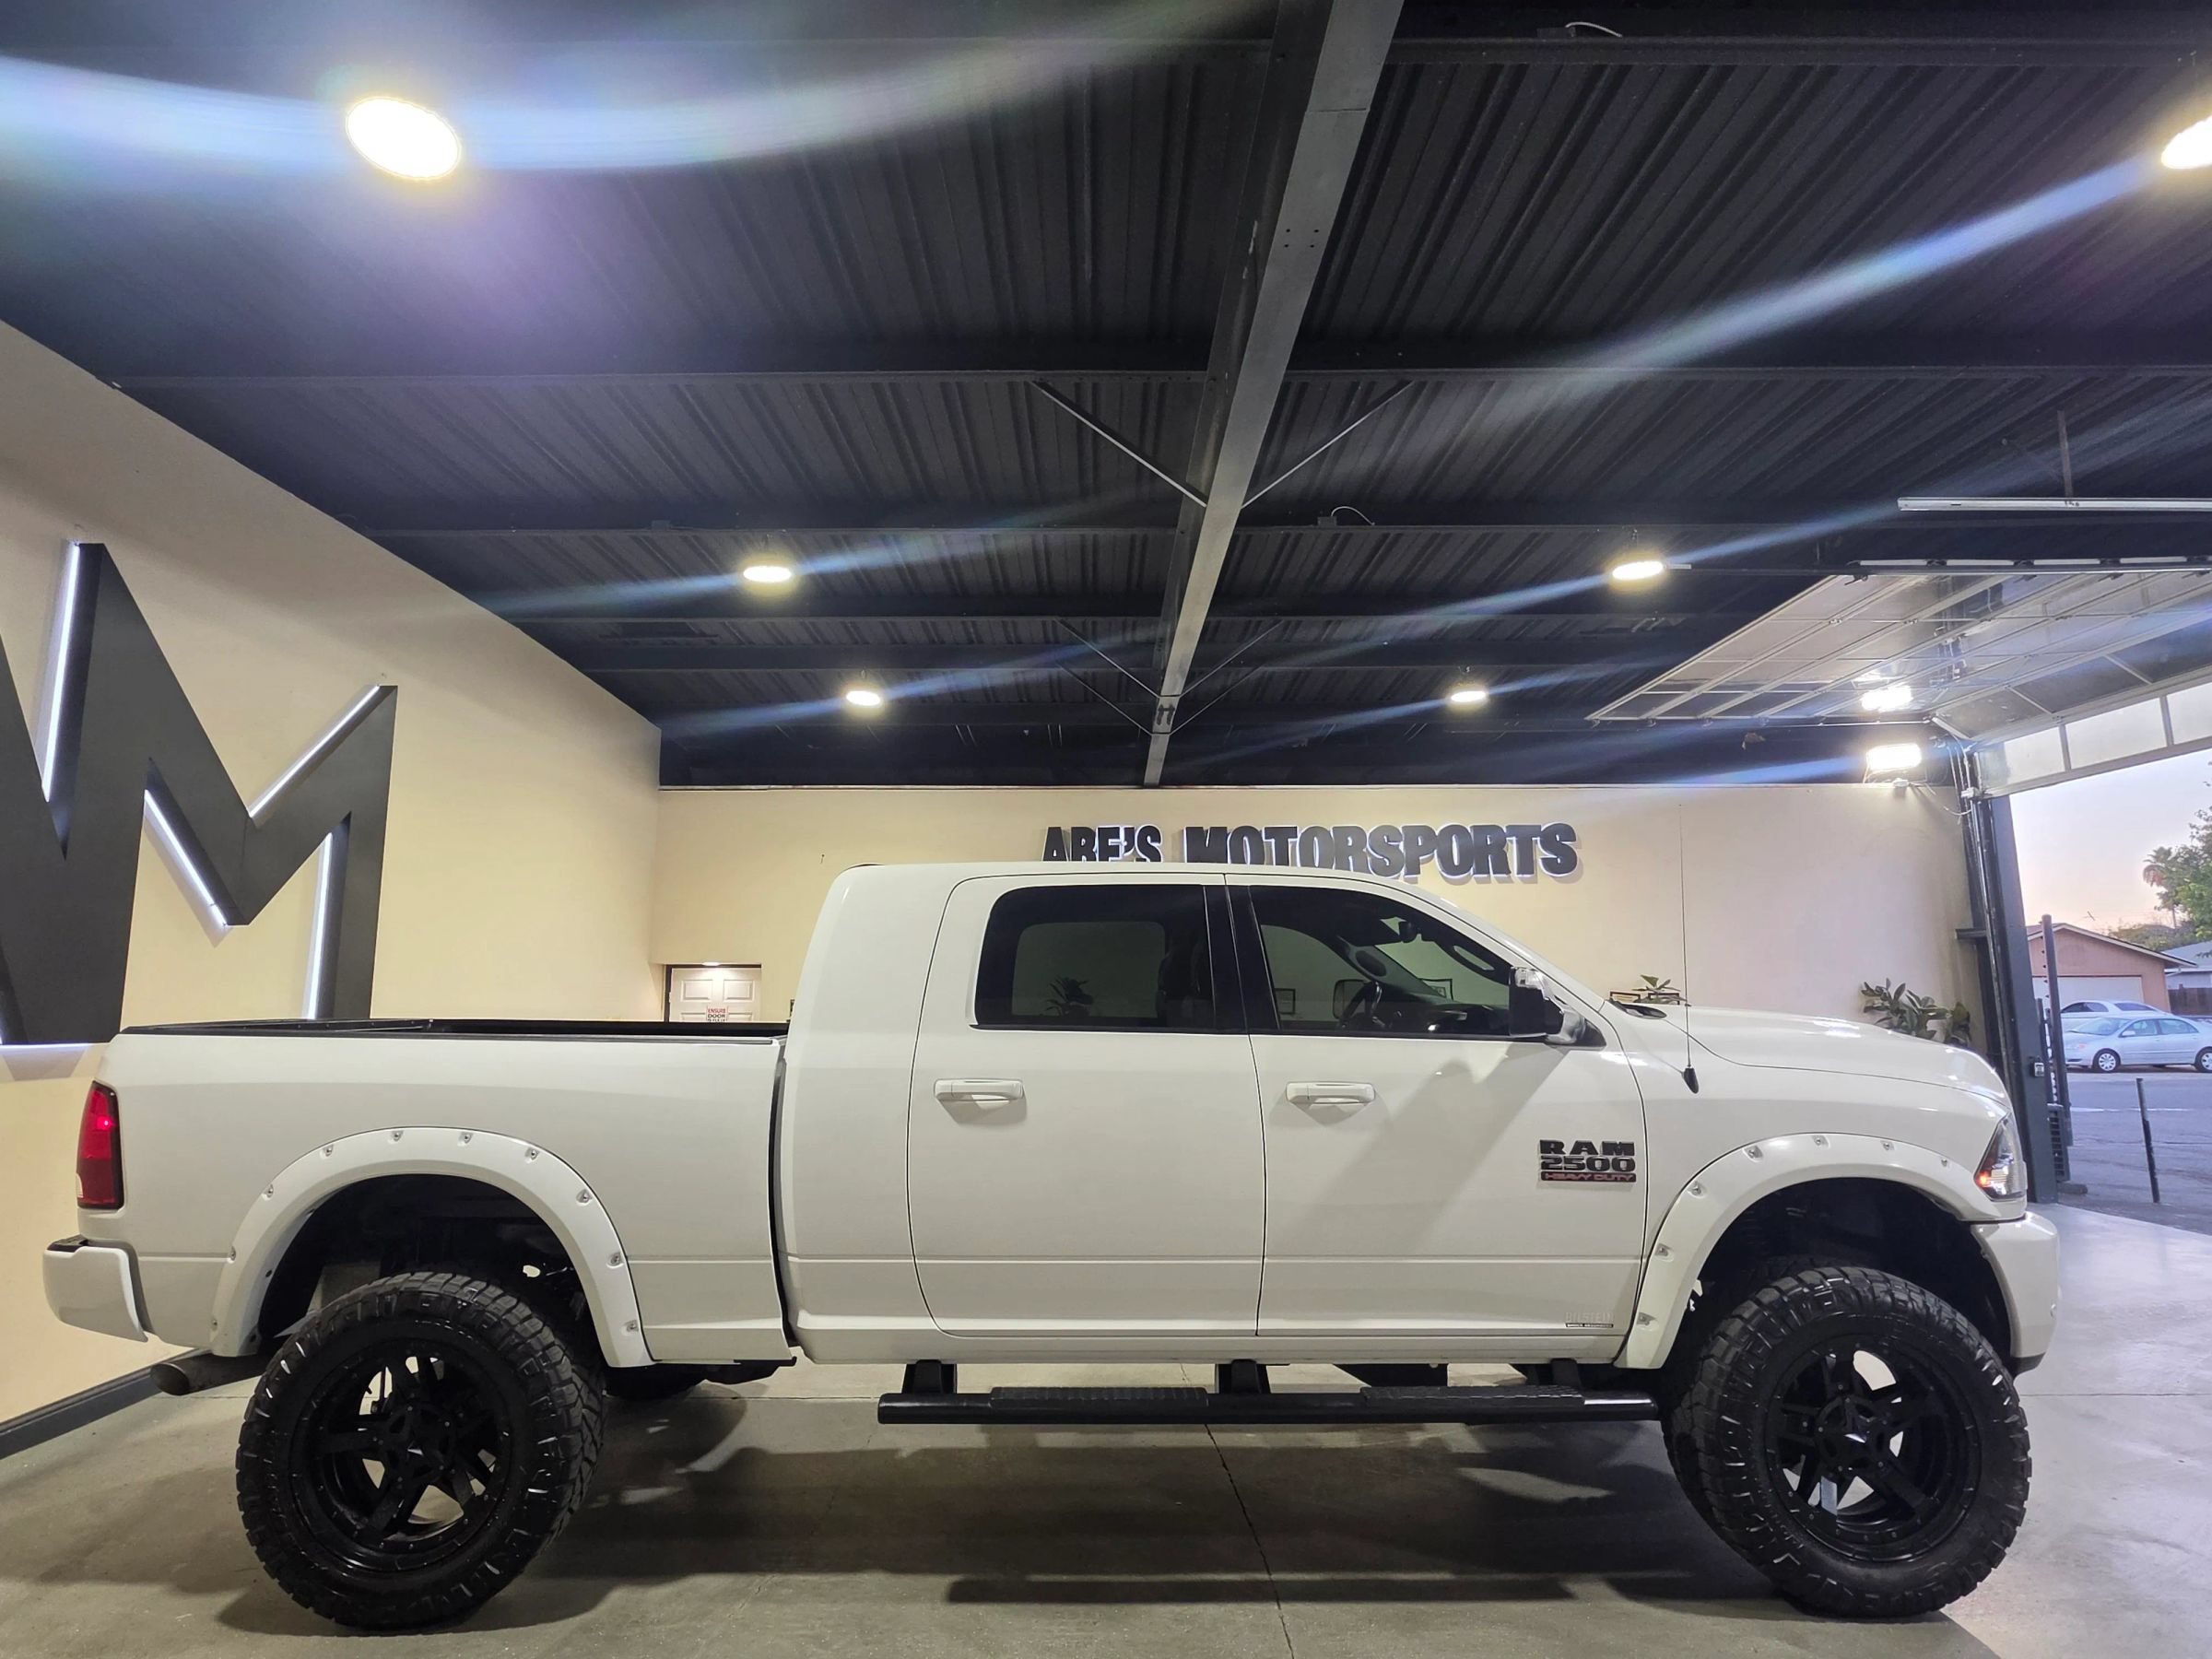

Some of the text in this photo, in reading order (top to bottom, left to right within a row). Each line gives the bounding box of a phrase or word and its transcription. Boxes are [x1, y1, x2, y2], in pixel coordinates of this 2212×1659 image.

[1184, 822, 1579, 878] MOTORSPORTS
[1539, 1139, 1635, 1156] RAM
[1541, 1156, 1636, 1171] 2500
[1545, 1172, 1633, 1182] HEAVY DUTY
